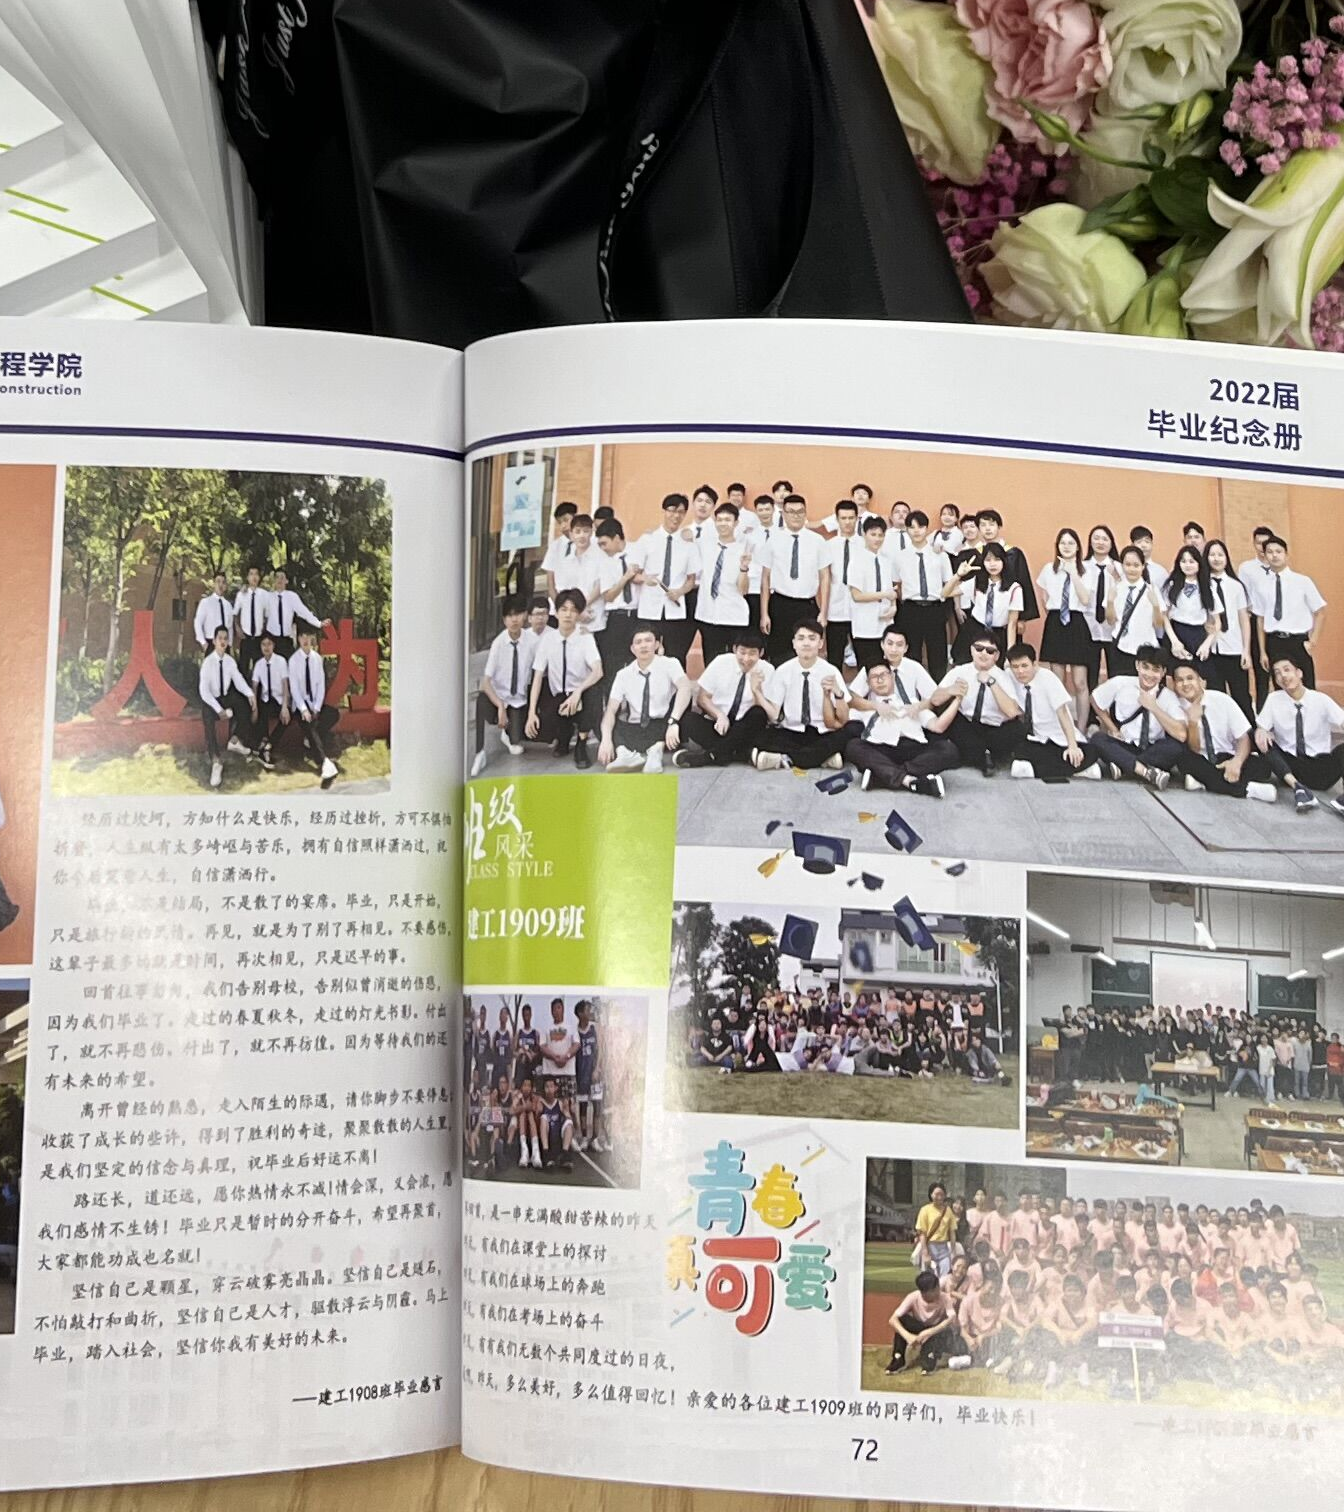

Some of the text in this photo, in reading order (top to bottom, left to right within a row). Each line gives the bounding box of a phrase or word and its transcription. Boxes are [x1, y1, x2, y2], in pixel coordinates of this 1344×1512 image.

[262, 1, 296, 96] Just
[1209, 379, 1300, 411] 2022届
[1147, 408, 1303, 451] 毕业纪念册
[507, 861, 554, 877] STYLE
[468, 904, 586, 940] 建工1909班
[44, 1070, 155, 1091] 有未来的希望。
[688, 1139, 807, 1237] 青春
[850, 1437, 879, 1462] 72
